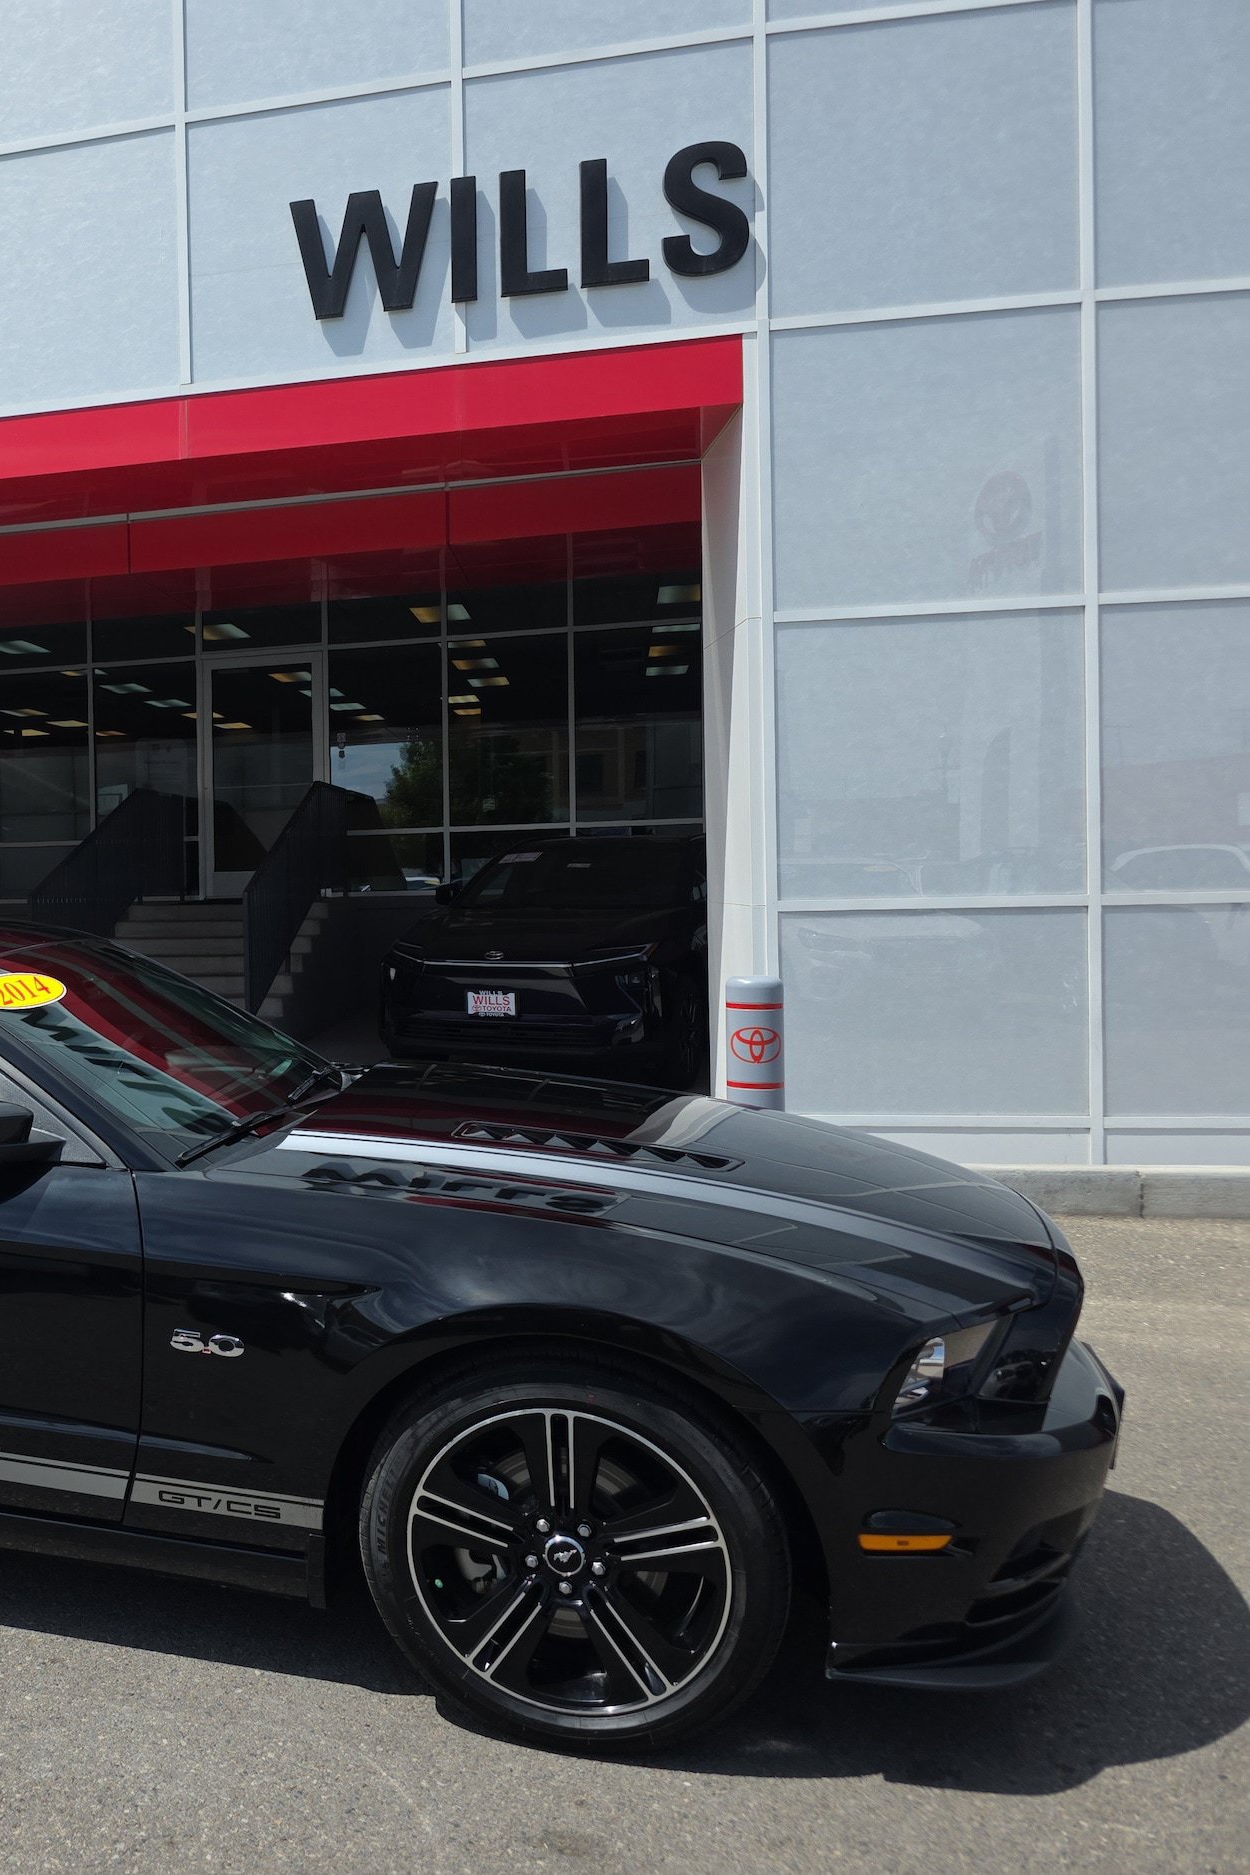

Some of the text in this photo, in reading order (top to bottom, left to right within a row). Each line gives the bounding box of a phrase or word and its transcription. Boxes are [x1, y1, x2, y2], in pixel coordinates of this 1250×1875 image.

[290, 140, 749, 321] WILLS
[472, 996, 511, 1005] WILLS
[170, 1328, 245, 1358] 5.0
[158, 1490, 281, 1520] GT/CS
